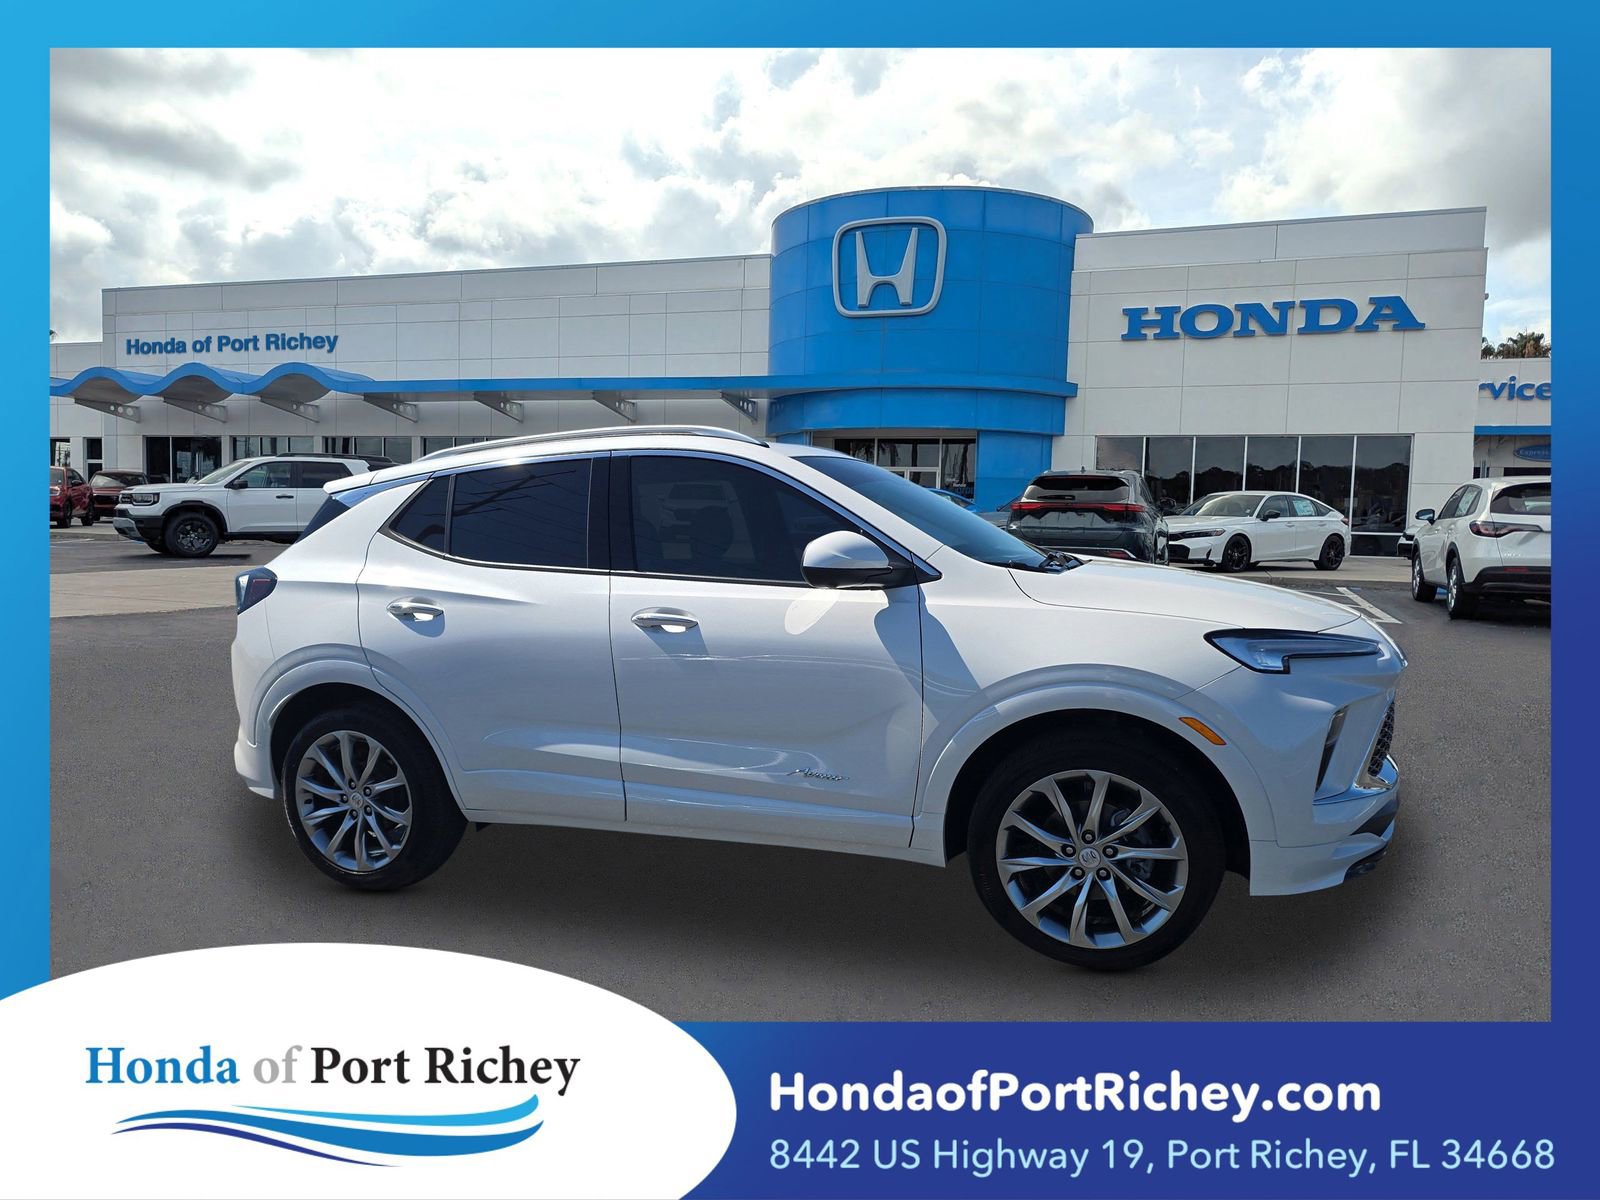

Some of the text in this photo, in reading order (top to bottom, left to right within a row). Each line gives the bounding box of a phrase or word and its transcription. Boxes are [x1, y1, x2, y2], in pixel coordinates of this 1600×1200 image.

[1121, 296, 1425, 341] HONDA
[126, 332, 339, 355] Honda of Port Richey
